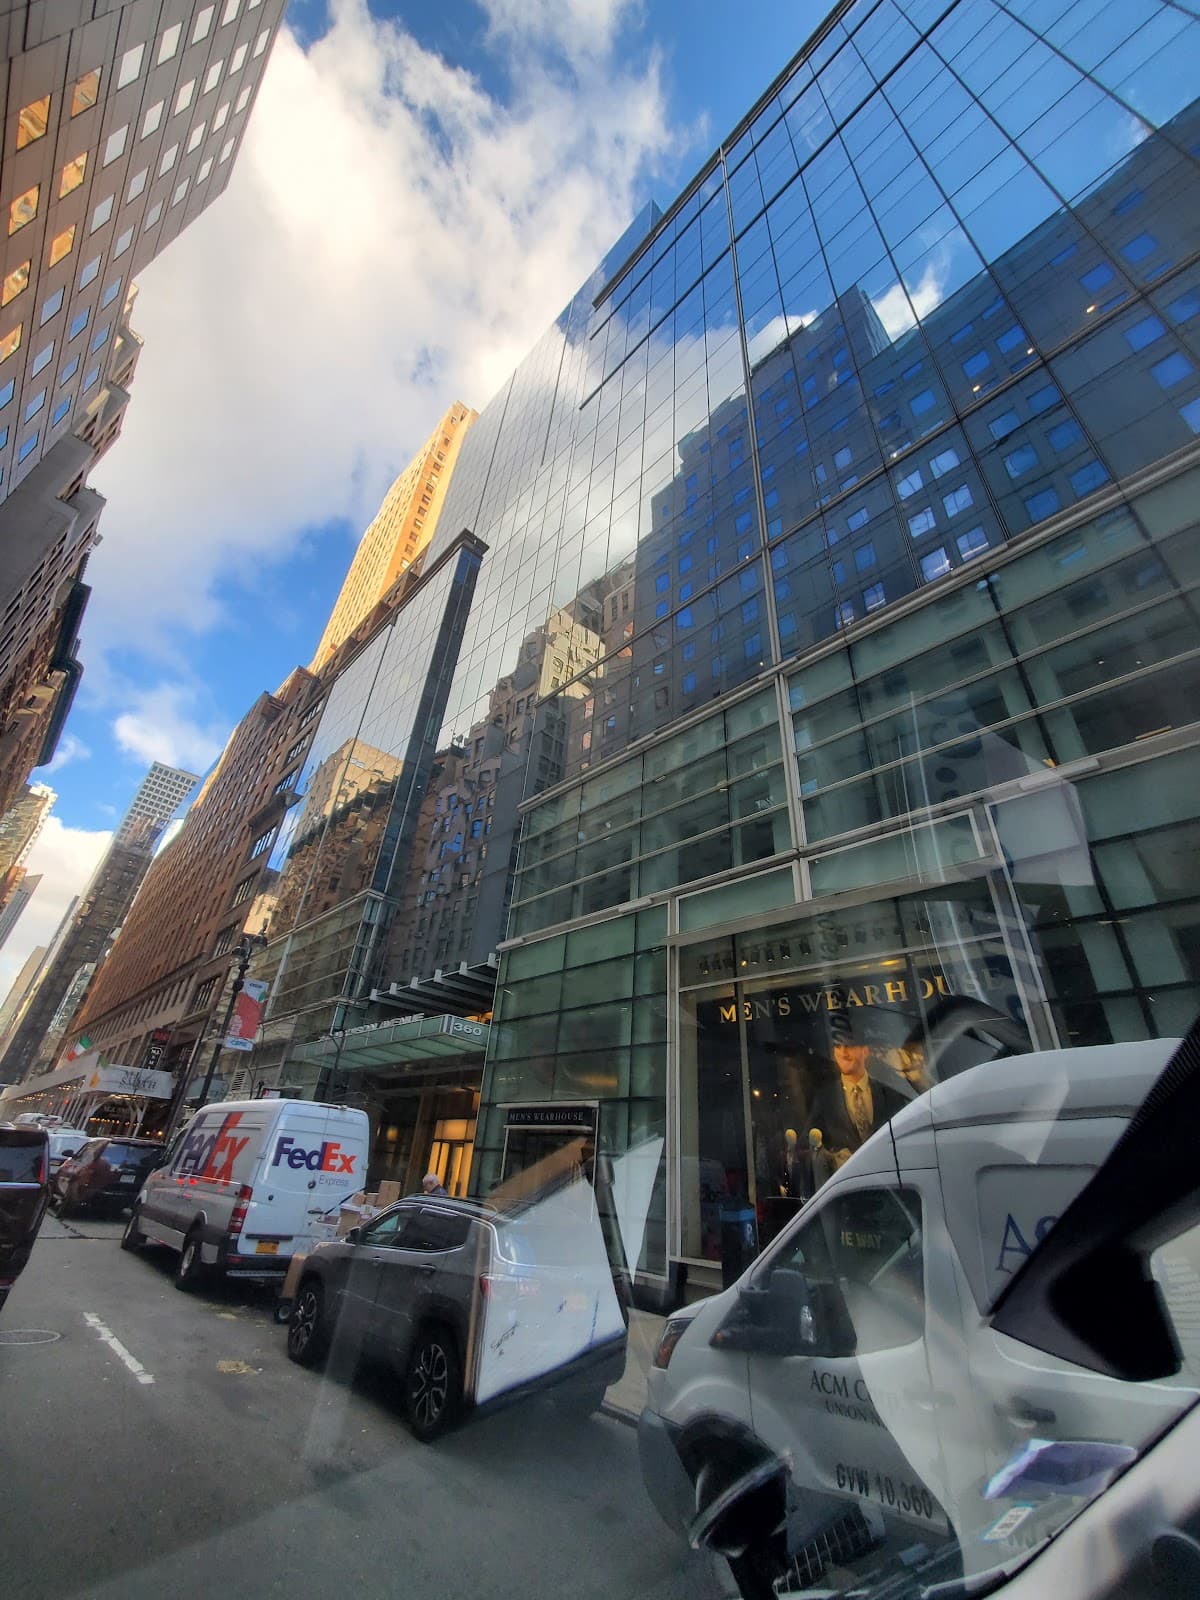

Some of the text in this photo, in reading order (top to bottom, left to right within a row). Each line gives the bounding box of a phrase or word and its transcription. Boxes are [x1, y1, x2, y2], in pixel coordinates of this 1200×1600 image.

[718, 996, 792, 1024] MEN'S
[453, 1022, 482, 1036] 360
[509, 1111, 584, 1121] MEN'S WEARHOUSE
[170, 1111, 250, 1187] FedEx
[271, 1136, 357, 1174] FedEx
[318, 1174, 350, 1188] Express
[810, 1370, 849, 1398] ACM
[825, 1400, 867, 1421] UNION
[836, 1462, 870, 1497] GVW
